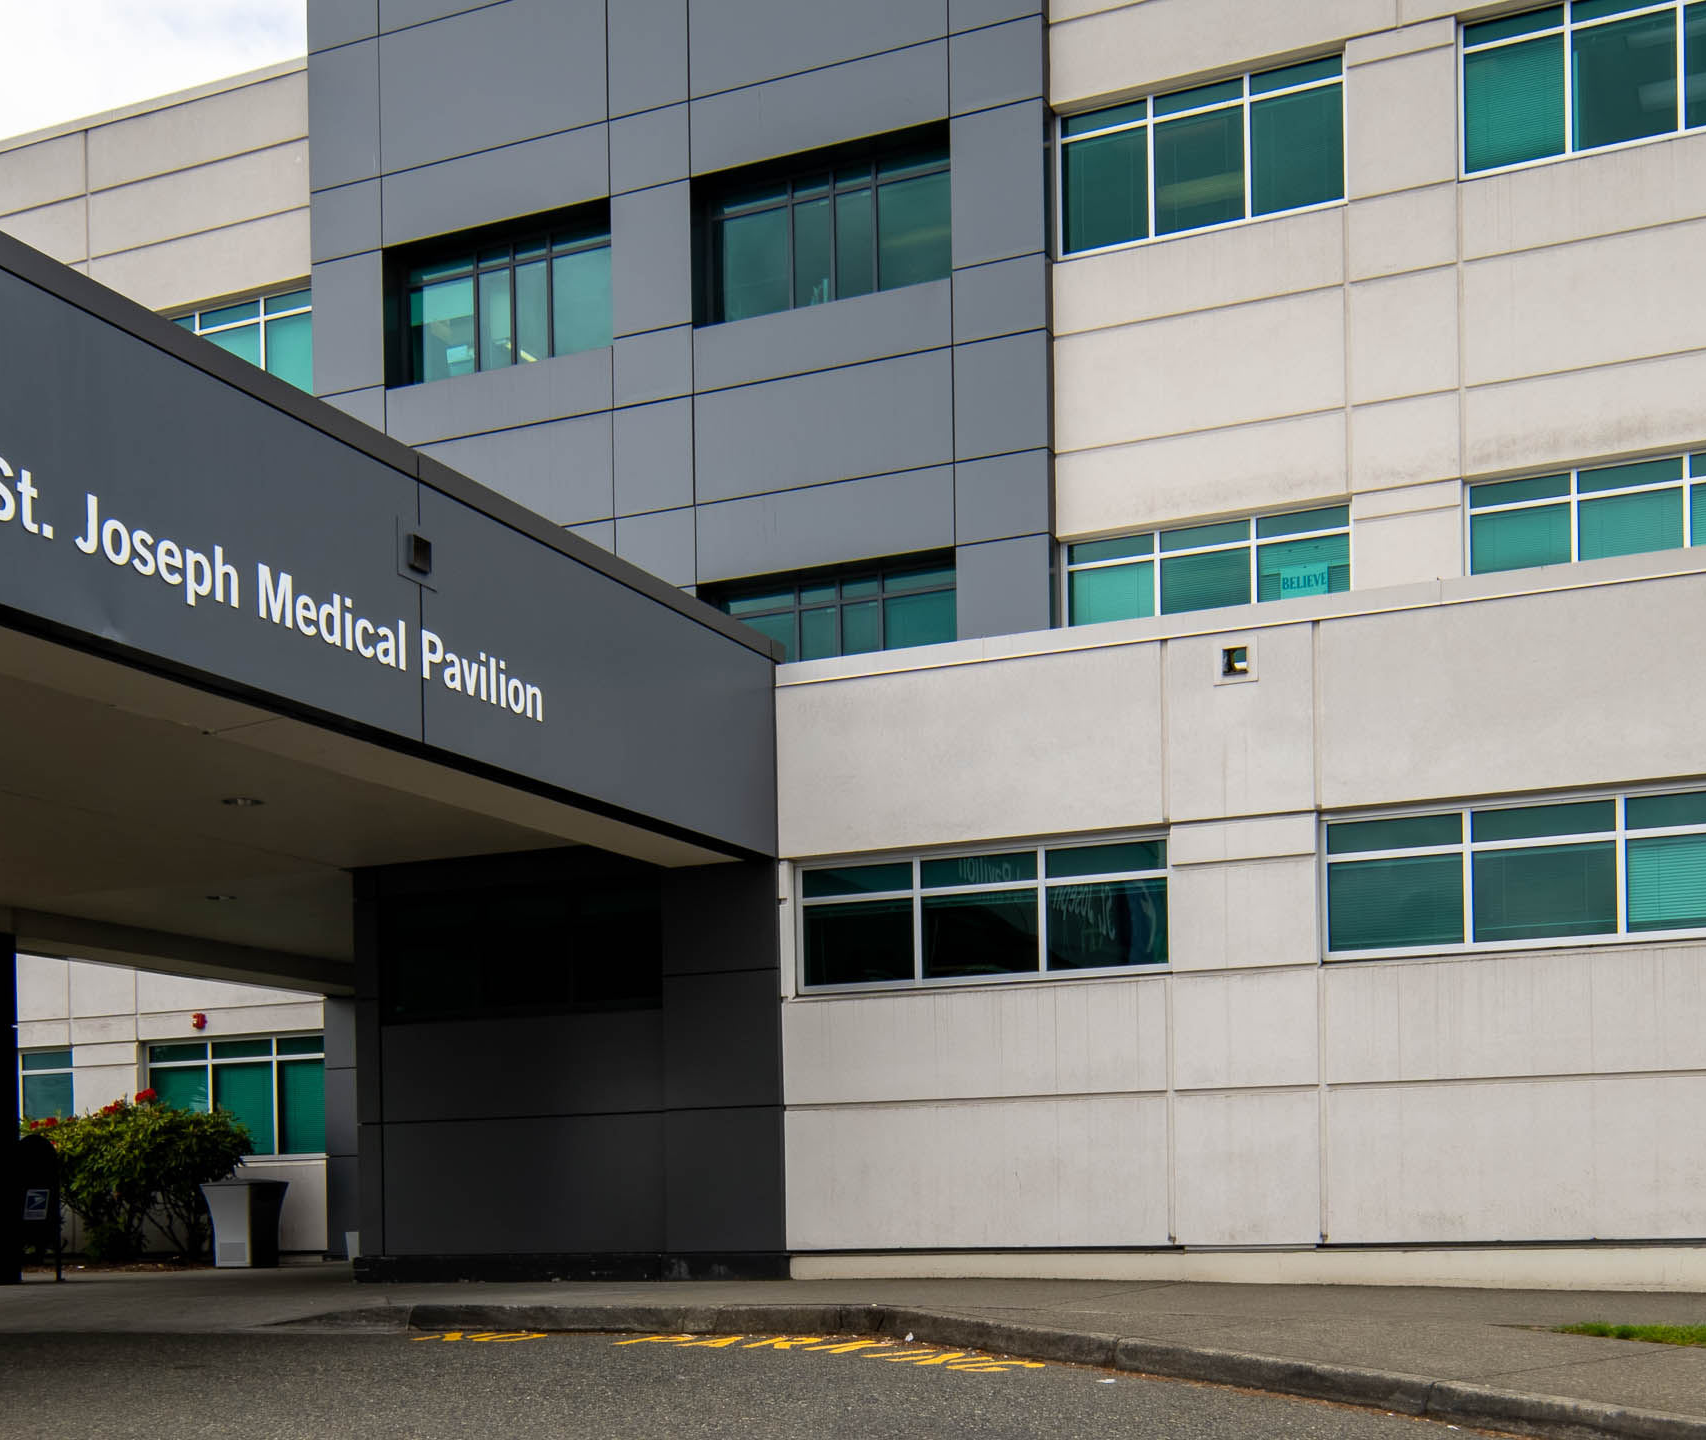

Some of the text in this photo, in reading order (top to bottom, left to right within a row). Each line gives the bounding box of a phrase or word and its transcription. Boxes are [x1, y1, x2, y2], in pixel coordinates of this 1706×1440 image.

[1281, 571, 1327, 590] BELIEVE
[74, 493, 239, 608] Joseph
[257, 562, 407, 672] Medical
[421, 629, 543, 722] Pavilion
[412, 1332, 1046, 1372] NO PARKING
